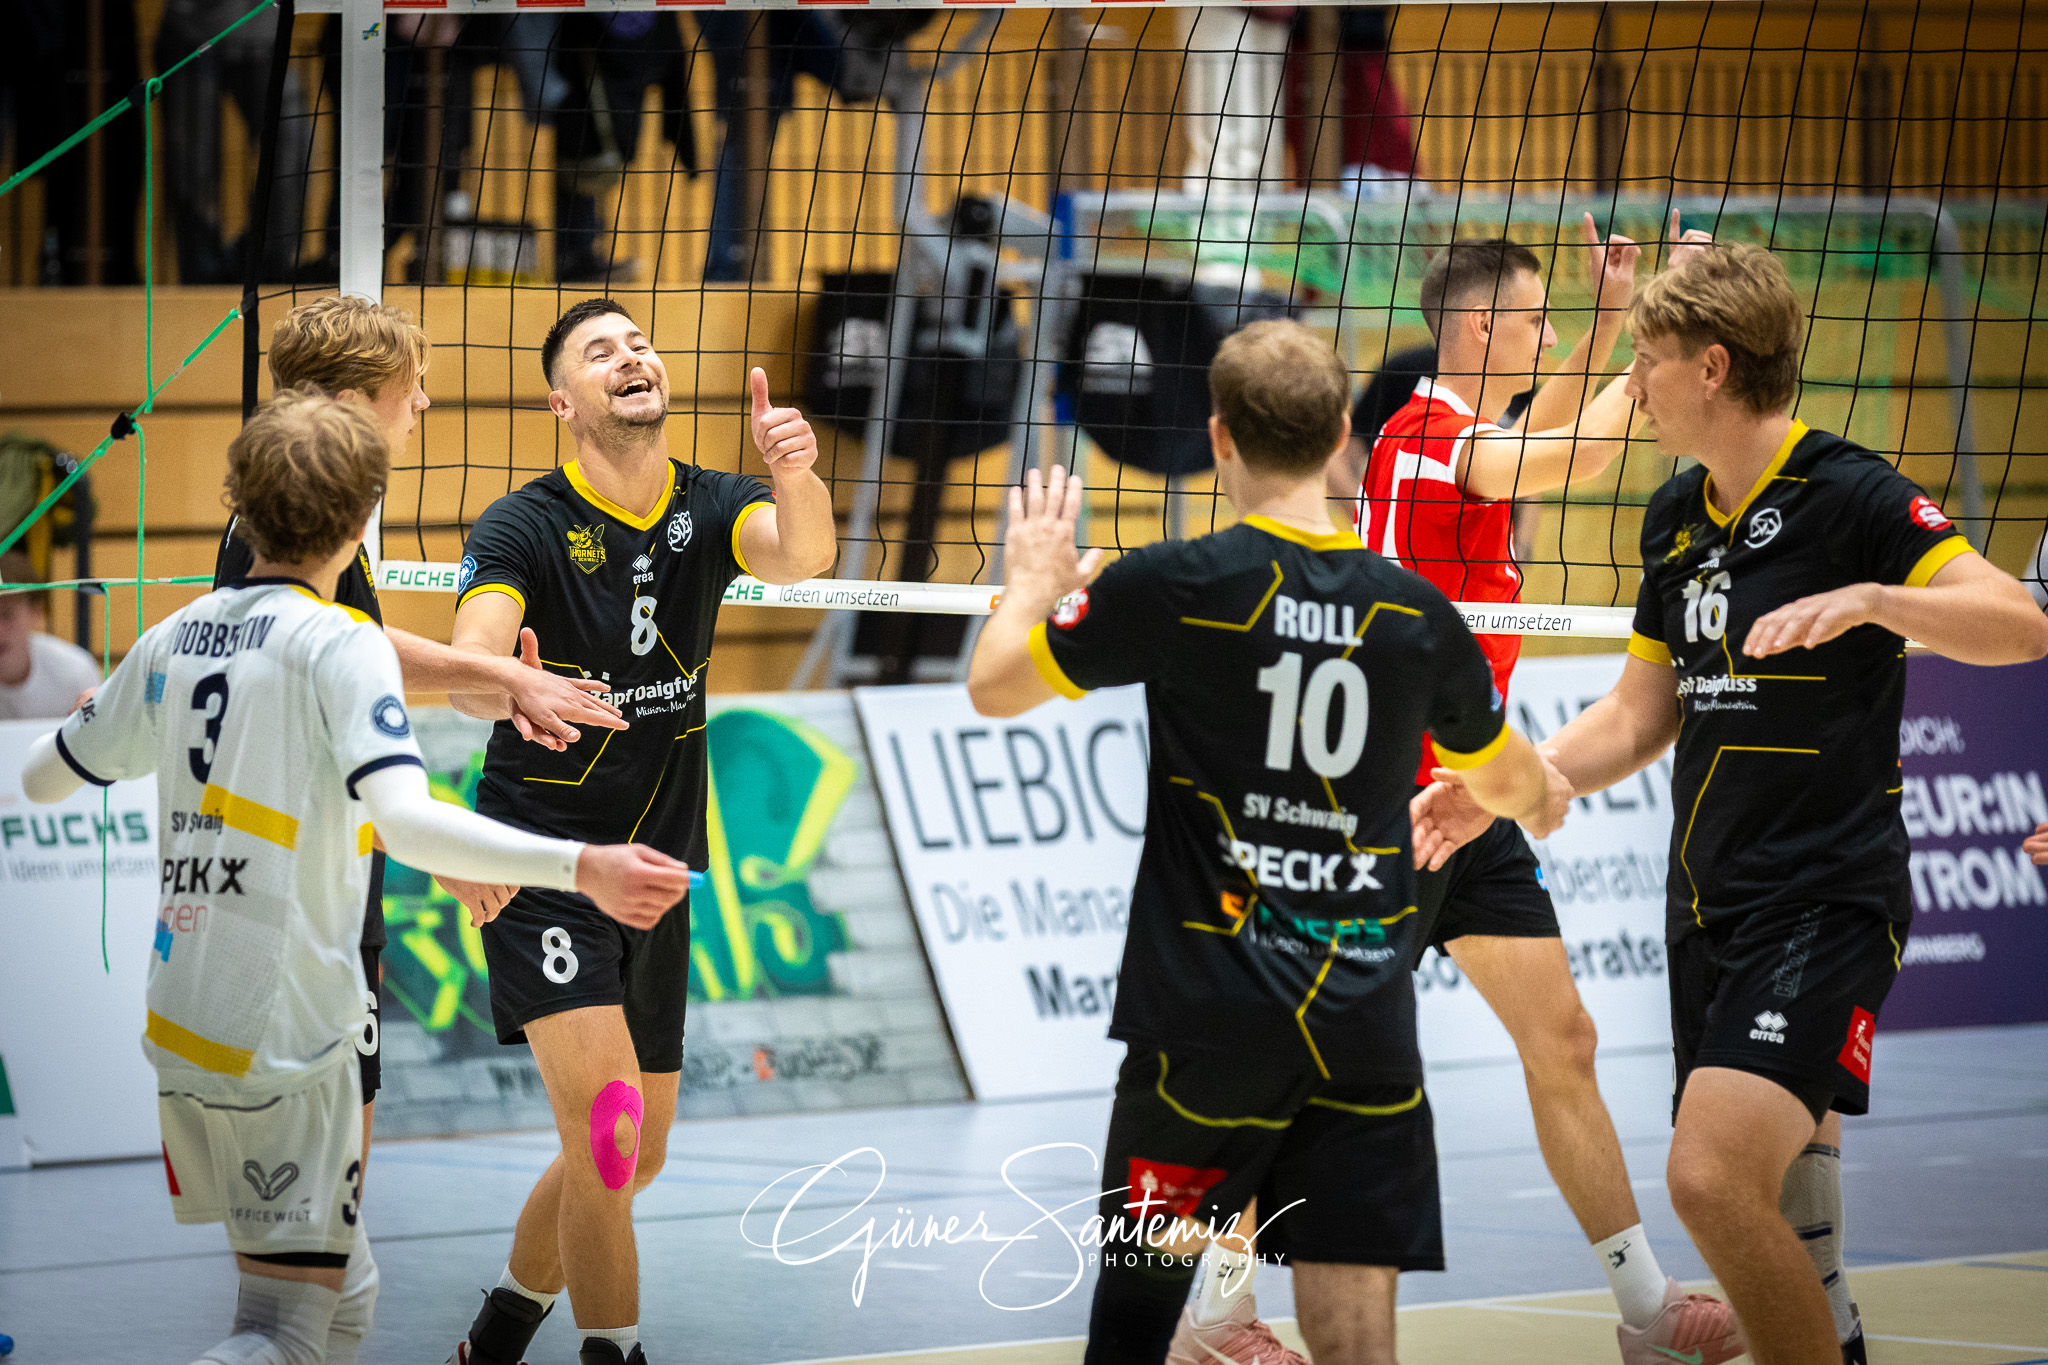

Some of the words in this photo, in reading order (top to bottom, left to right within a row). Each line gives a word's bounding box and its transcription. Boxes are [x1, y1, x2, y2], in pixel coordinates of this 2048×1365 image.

[386, 570, 455, 587] FUCHS
[572, 549, 605, 559] HORNETS
[723, 584, 765, 601] CHS
[779, 584, 820, 604] Ideen
[825, 588, 899, 607] umsetzen
[1682, 571, 1732, 642] 16
[631, 596, 658, 656] 8
[1274, 594, 1363, 647] ROLL
[1491, 613, 1572, 632] umsetzen
[634, 671, 698, 700] Daigfus
[1696, 673, 1757, 697] Daigfuss
[188, 672, 229, 785] 3
[1257, 651, 1369, 779] 10
[1, 811, 149, 849] FUCHS
[1243, 792, 1271, 819] SV
[1273, 796, 1359, 838] Schwaig
[930, 879, 1006, 943] Die
[541, 926, 579, 984] 8
[353, 991, 379, 1056] 6
